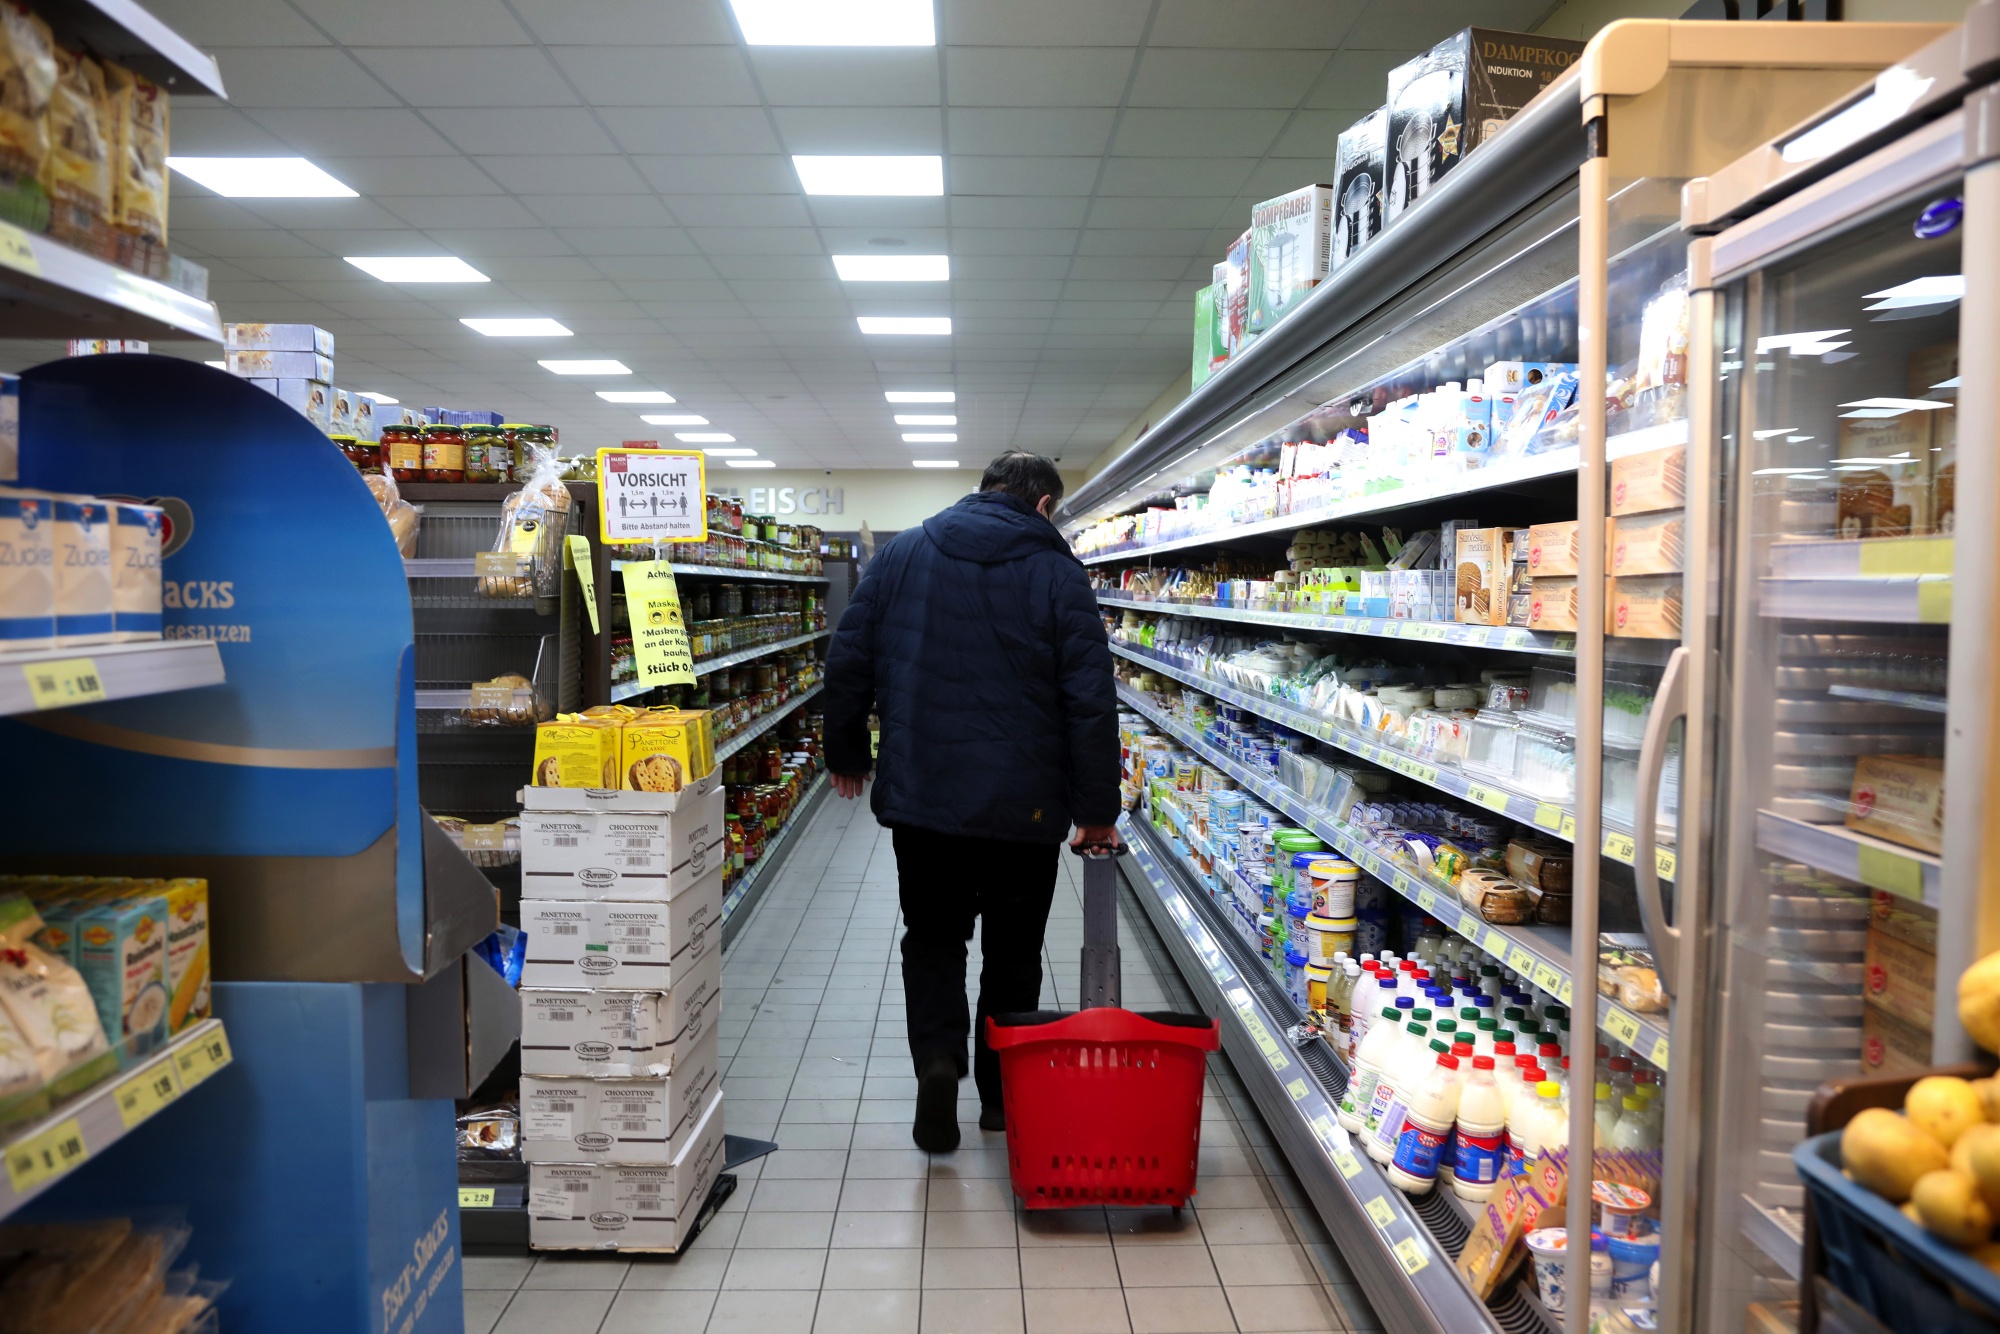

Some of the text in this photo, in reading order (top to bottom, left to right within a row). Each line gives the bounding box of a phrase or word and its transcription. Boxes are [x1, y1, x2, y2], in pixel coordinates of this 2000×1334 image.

[1487, 65, 1533, 78] INDUKTION
[1255, 193, 1312, 229] DAMPFGARER
[617, 473, 687, 487] VORSICHT
[621, 523, 639, 531] Bitte
[640, 522, 668, 530] Abstand
[648, 601, 676, 609] Maske
[644, 641, 656, 649] an
[659, 638, 673, 647] der
[647, 662, 680, 675] Stück
